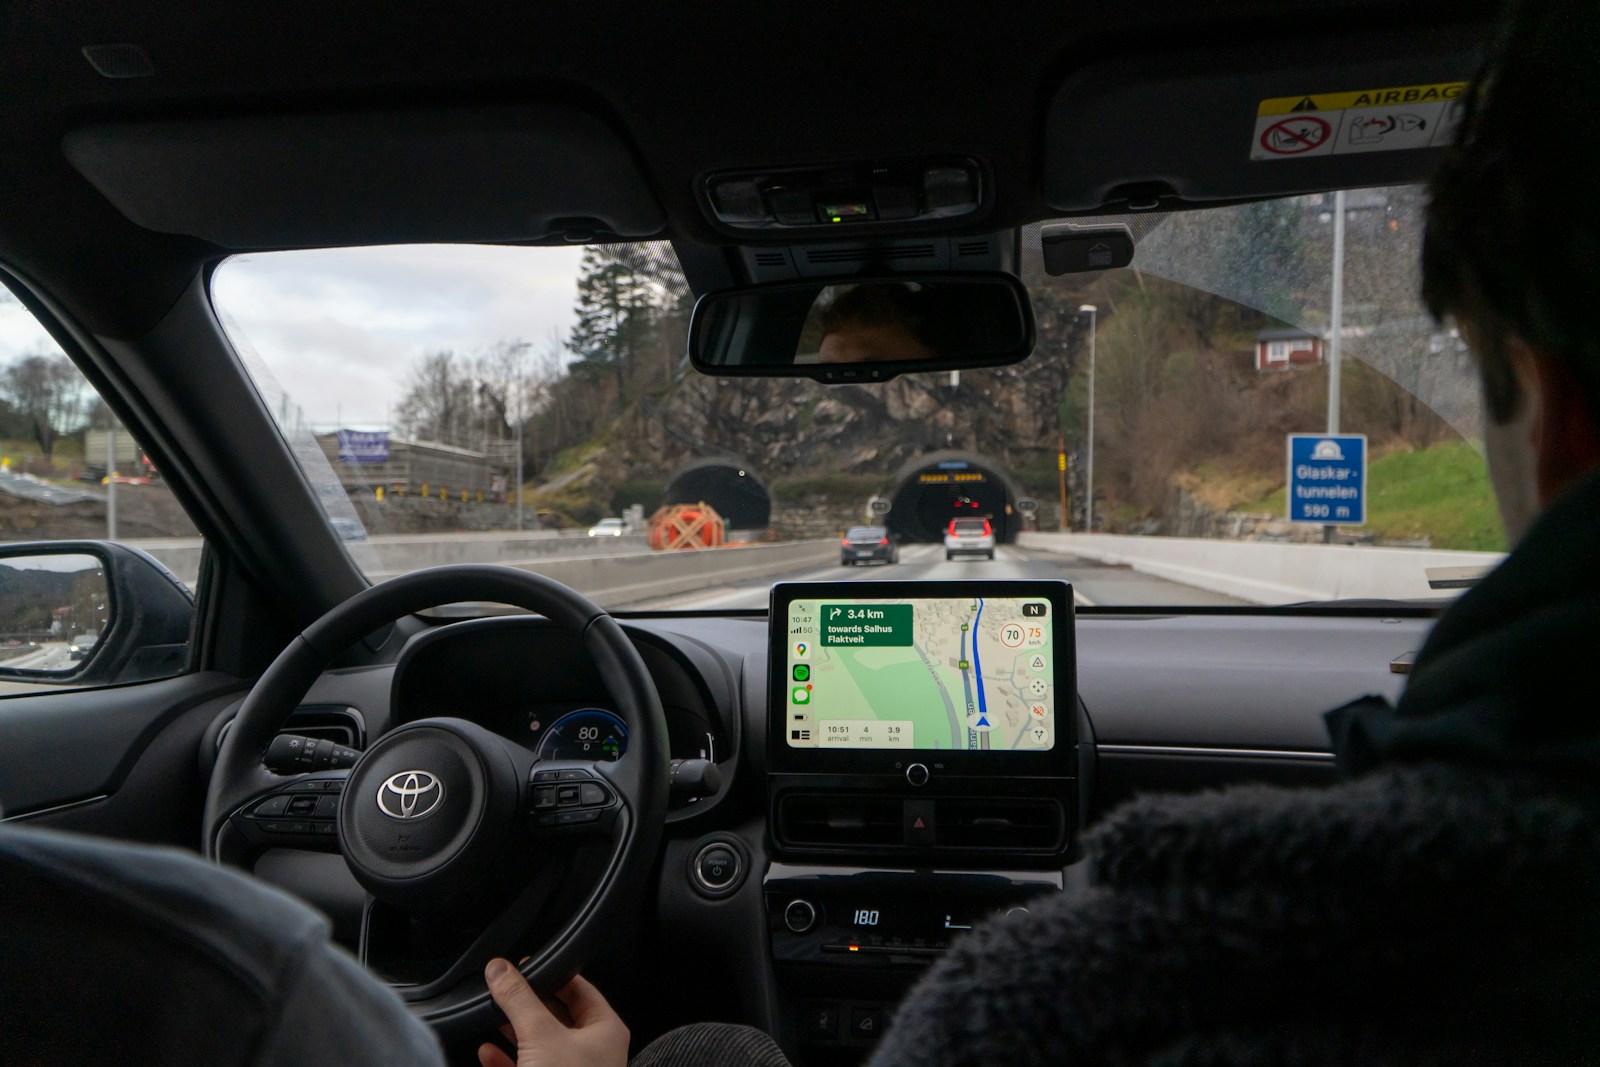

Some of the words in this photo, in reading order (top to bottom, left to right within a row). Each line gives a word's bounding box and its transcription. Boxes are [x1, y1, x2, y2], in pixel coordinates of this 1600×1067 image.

[1354, 86, 1461, 105] AIRBAG
[1296, 484, 1358, 499] tunnelen
[1303, 503, 1330, 518] 590
[1335, 506, 1350, 518] m
[847, 609, 865, 619] 3.4
[867, 609, 884, 619] km
[1030, 606, 1039, 615] N
[828, 625, 862, 633] towards
[864, 625, 893, 633] Salhus
[1028, 628, 1041, 638] 75
[828, 635, 865, 643] Flaktveit
[1006, 630, 1019, 640] 70
[578, 727, 598, 740] 80
[583, 743, 590, 751] D
